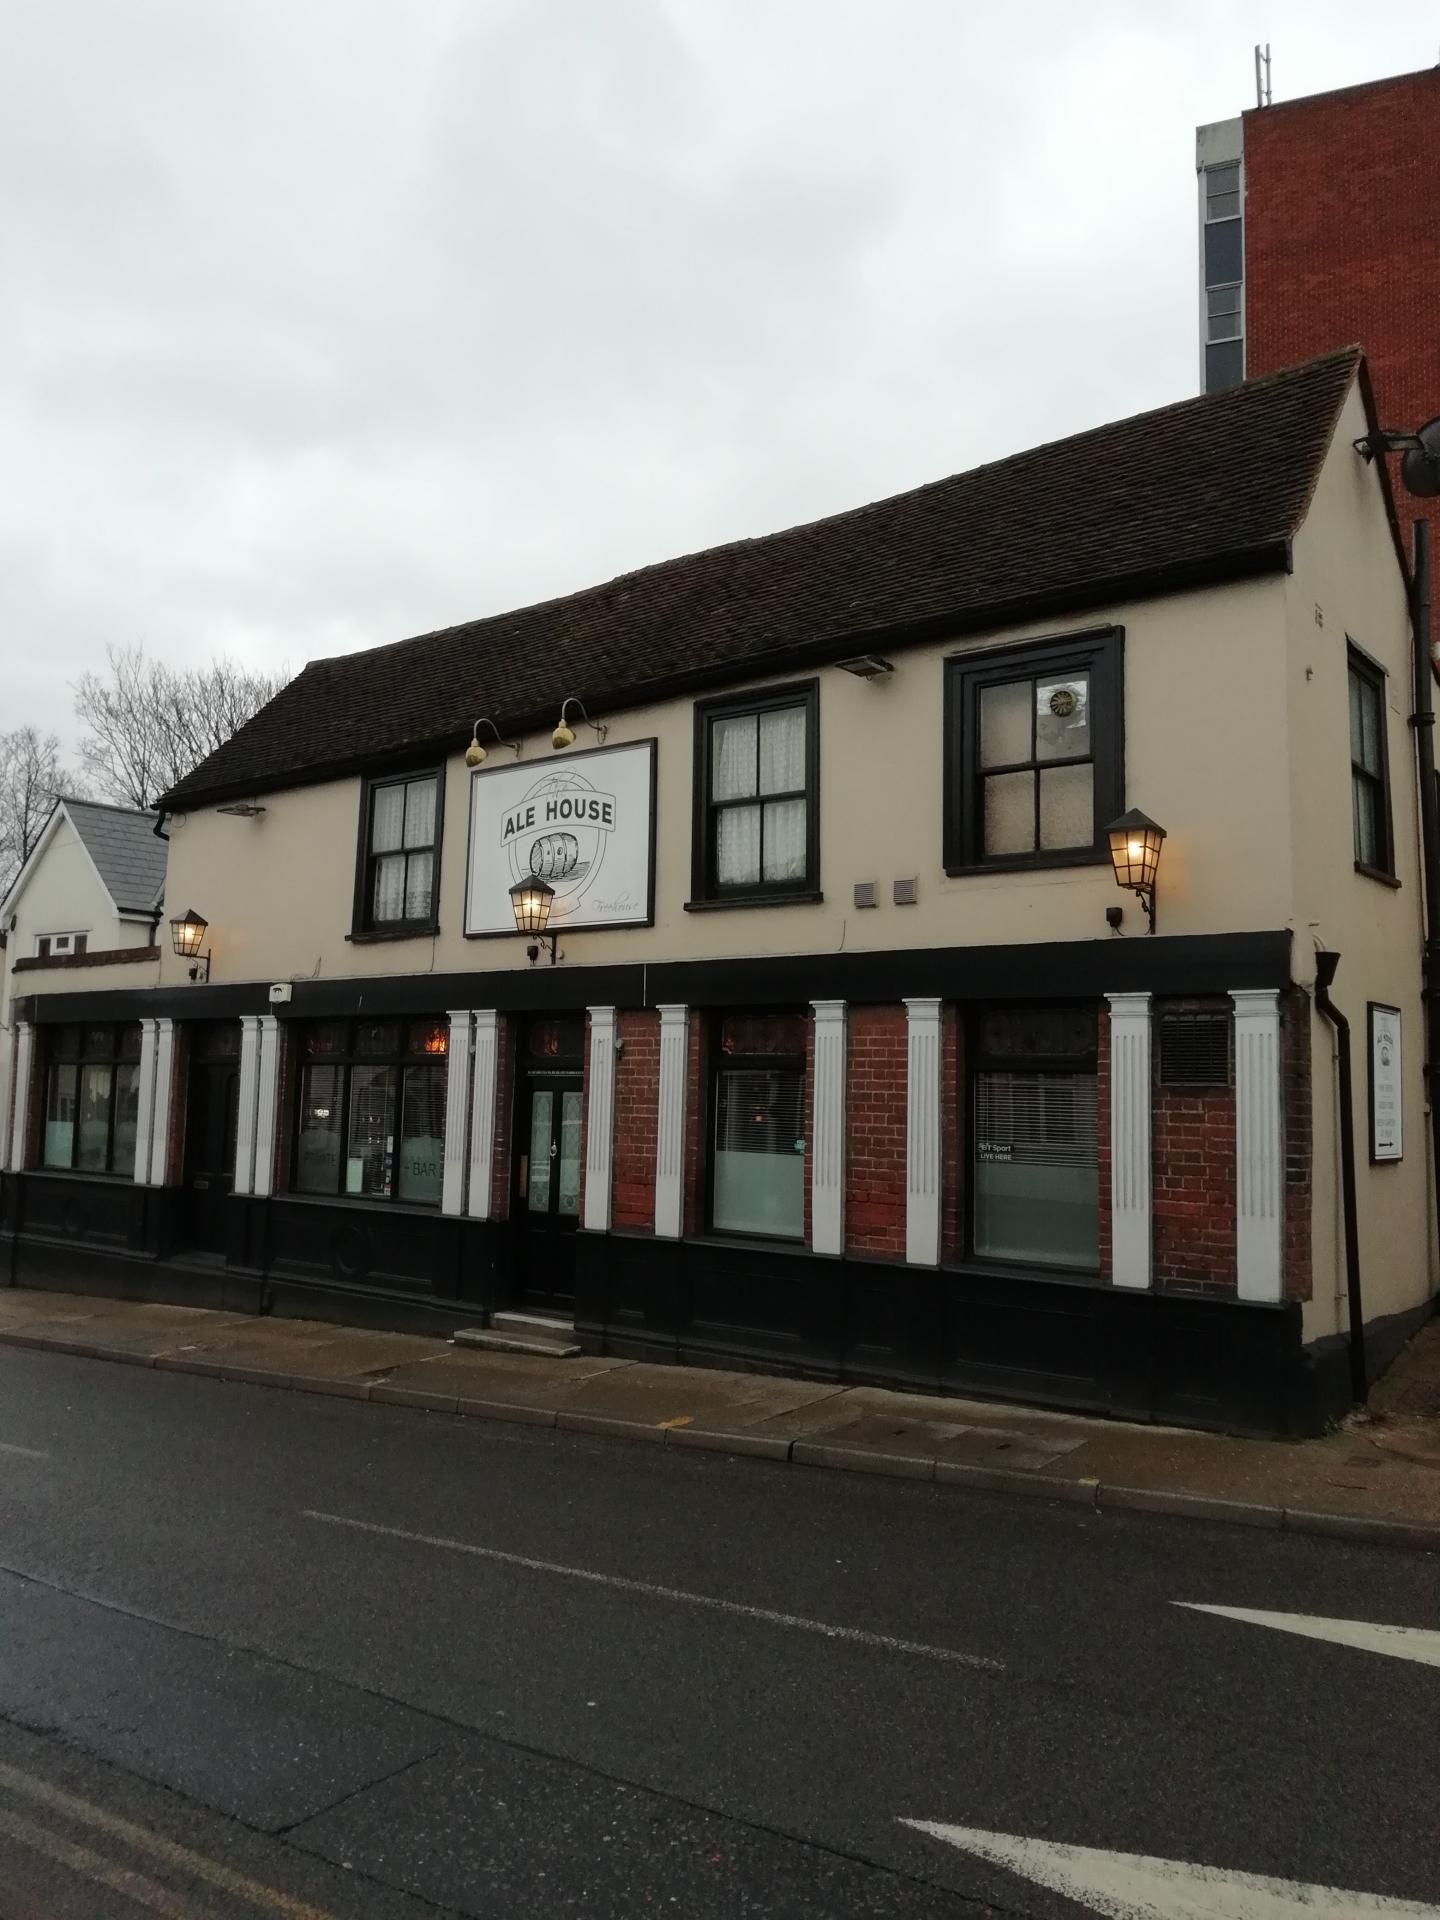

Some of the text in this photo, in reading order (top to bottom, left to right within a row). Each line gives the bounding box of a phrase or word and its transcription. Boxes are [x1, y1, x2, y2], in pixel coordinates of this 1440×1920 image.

[503, 798, 612, 840] ALE HOUSE
[992, 1144, 1011, 1153] Sport
[994, 1153, 1012, 1161] HERE
[413, 1161, 437, 1177] BAR
